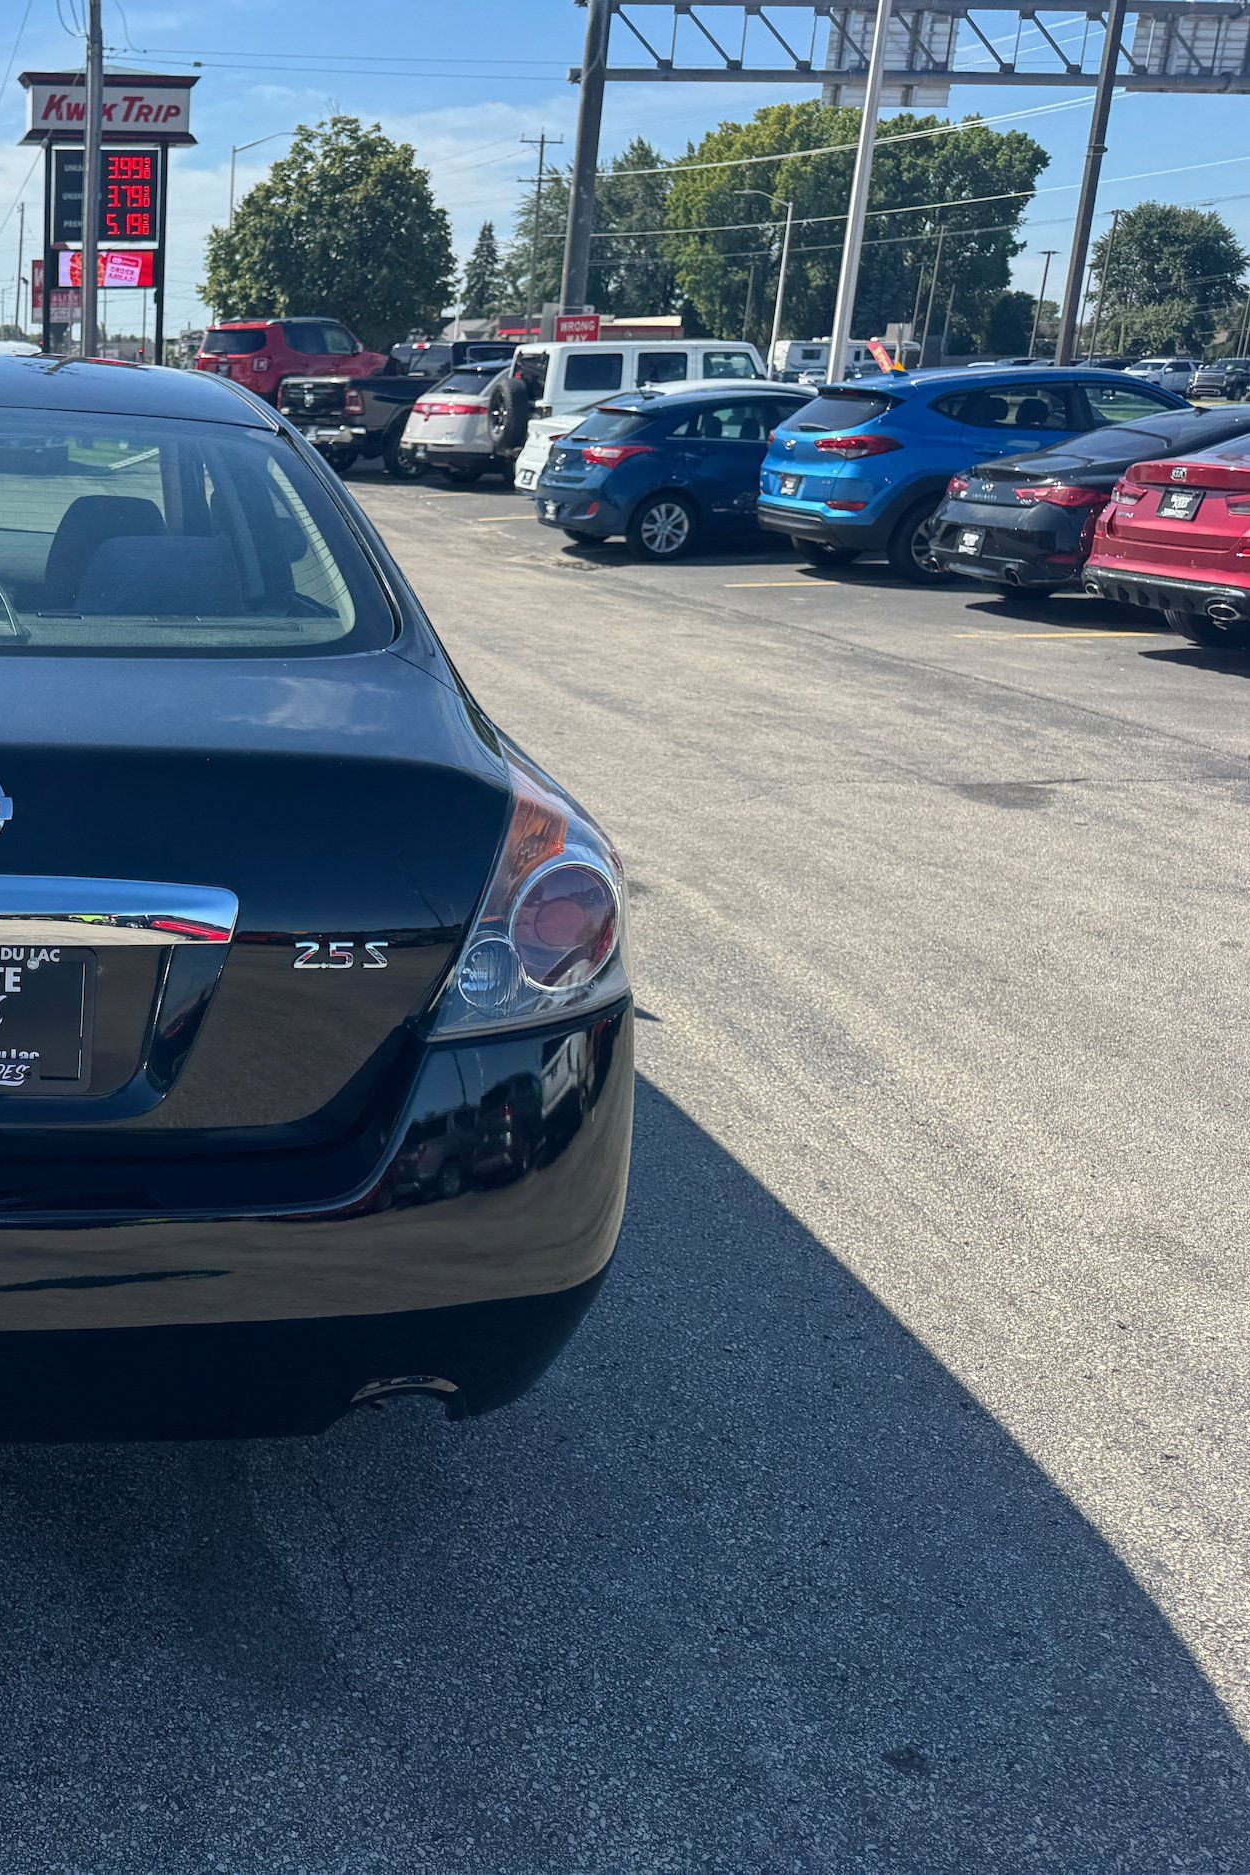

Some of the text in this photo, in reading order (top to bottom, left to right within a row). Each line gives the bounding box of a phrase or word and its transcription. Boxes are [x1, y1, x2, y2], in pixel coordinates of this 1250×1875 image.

[41, 94, 181, 123] KWK TRIP
[560, 320, 596, 332] WRONG
[566, 334, 589, 342] WAY
[0, 947, 25, 961] DU
[30, 948, 61, 963] LAC
